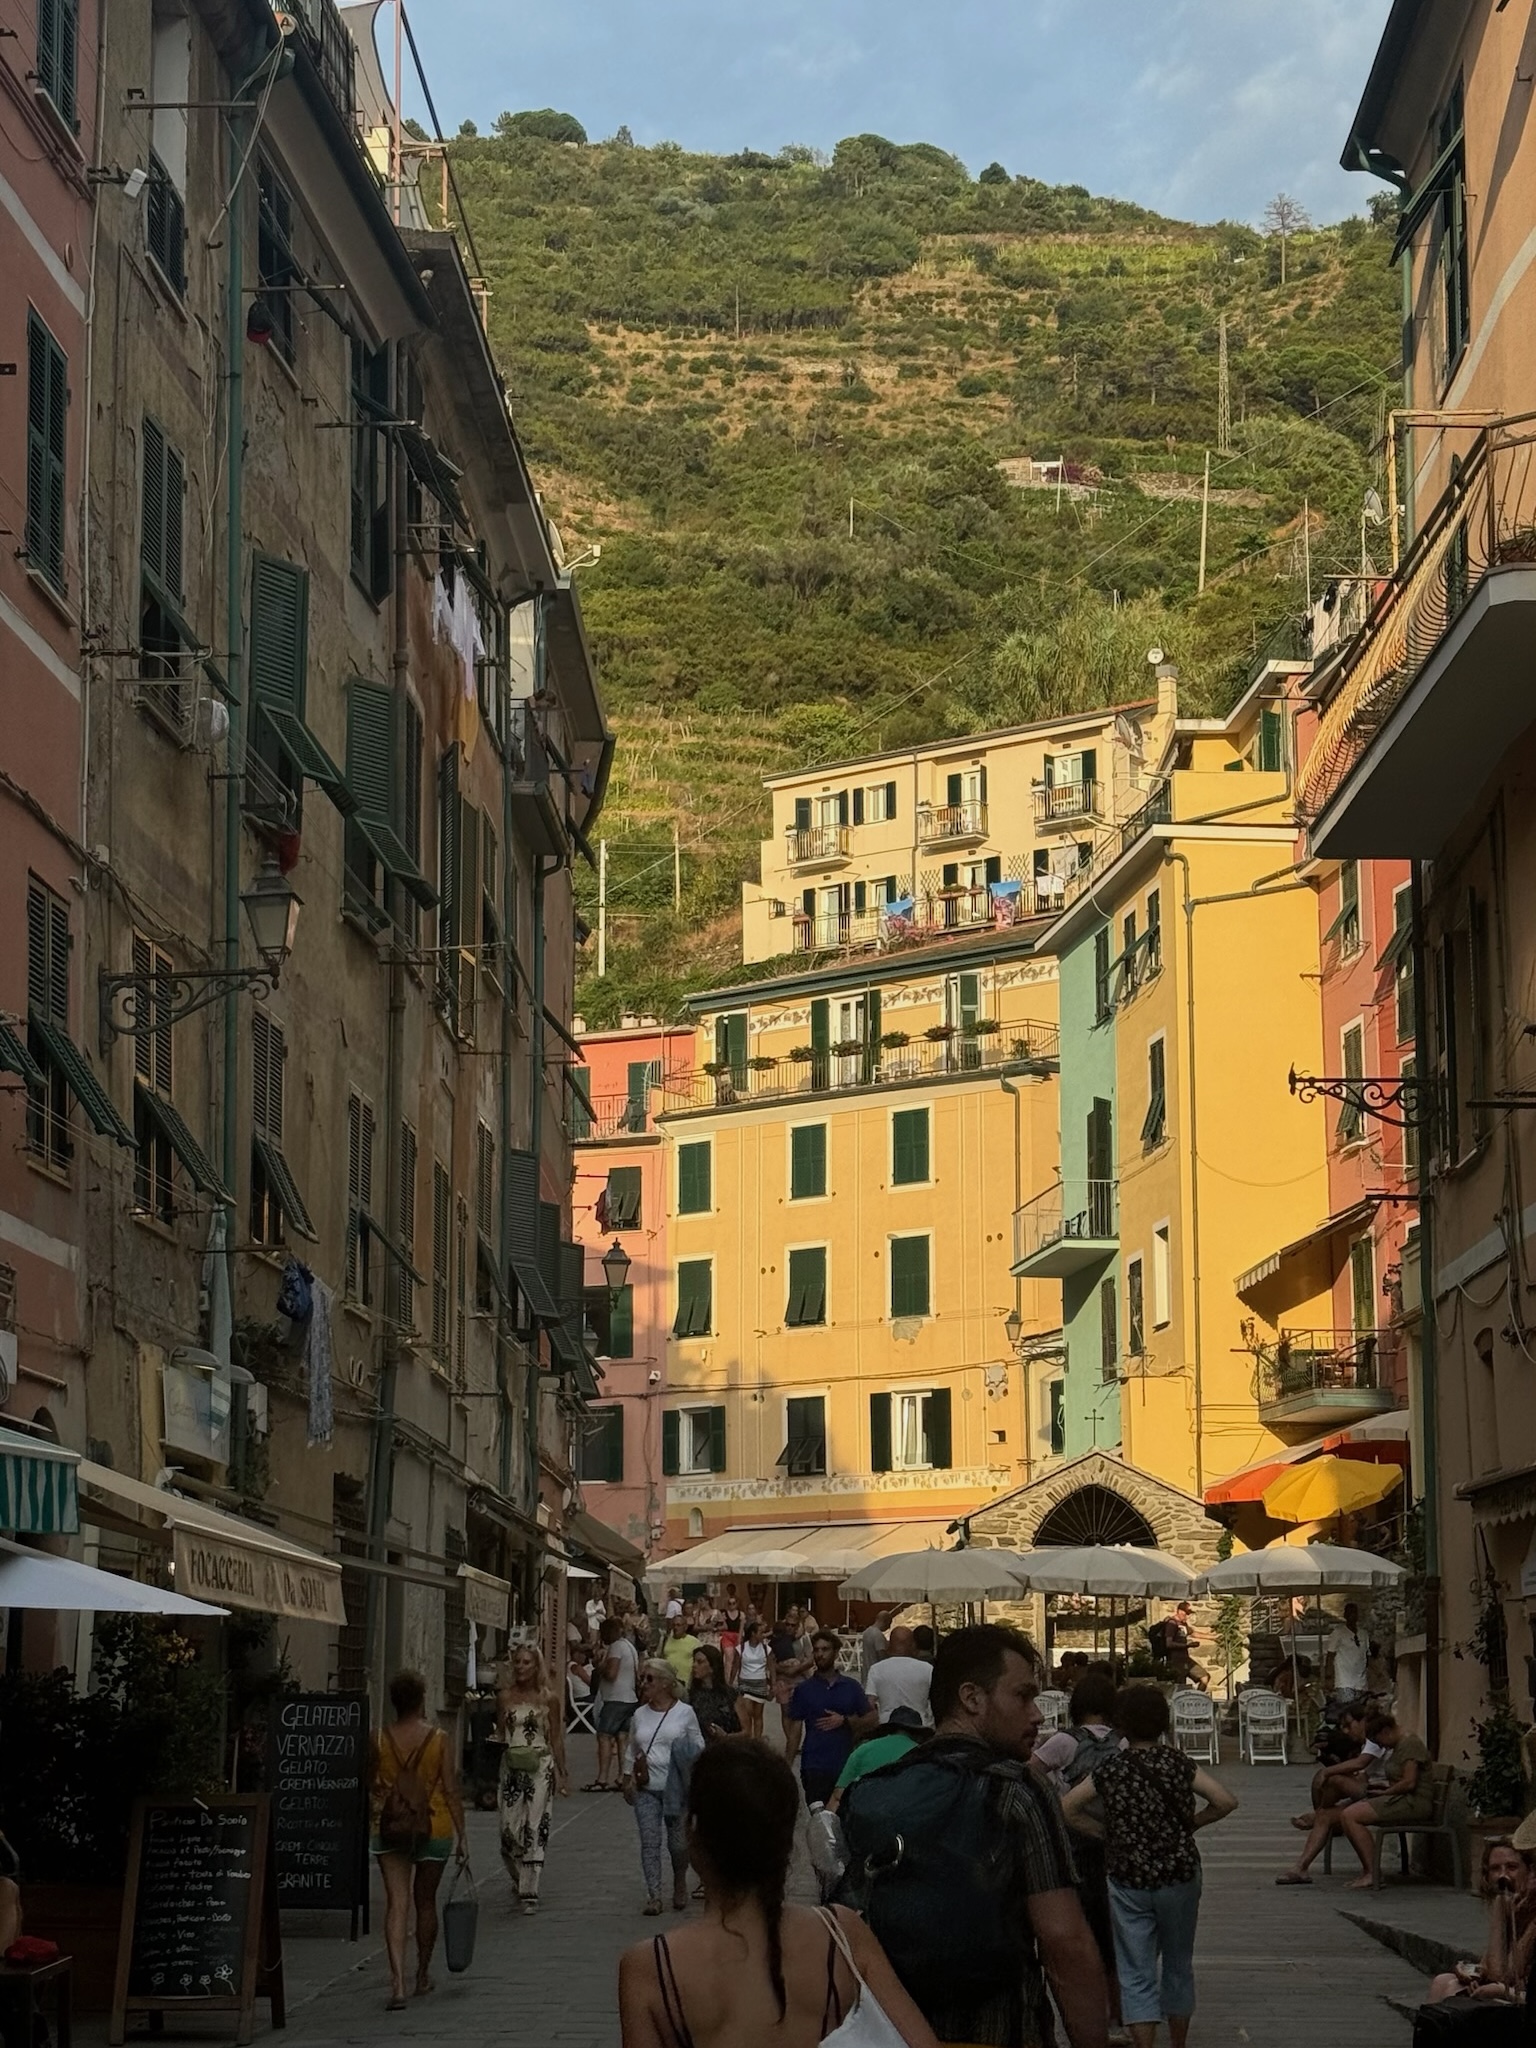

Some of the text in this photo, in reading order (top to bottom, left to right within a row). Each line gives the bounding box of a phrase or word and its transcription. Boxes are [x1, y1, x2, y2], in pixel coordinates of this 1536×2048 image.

[190, 1548, 255, 1597] FOCACCERIA
[281, 1701, 361, 1730] GELATERIA
[276, 1733, 355, 1758] VERNAZZA
[276, 1872, 333, 1889] GRANITE
